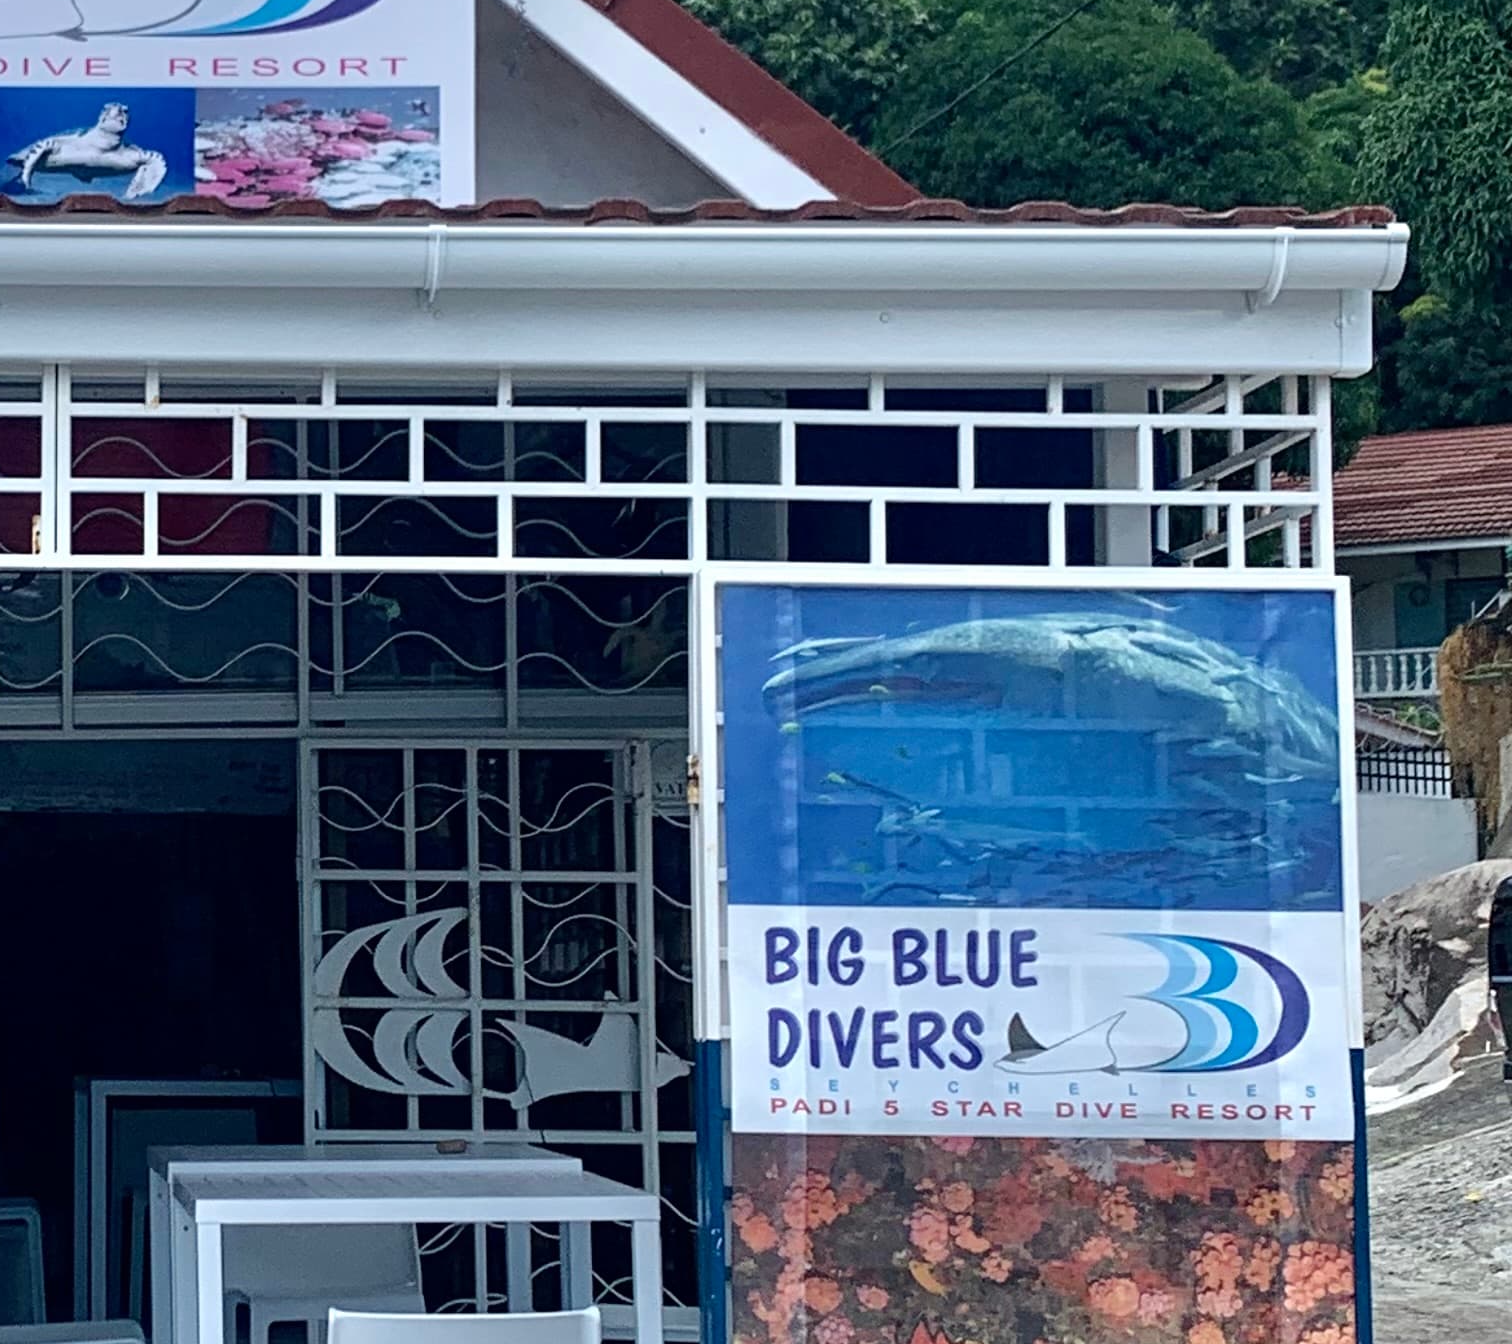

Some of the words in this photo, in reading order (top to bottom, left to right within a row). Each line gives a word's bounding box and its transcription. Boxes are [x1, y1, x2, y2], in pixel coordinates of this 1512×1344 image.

[168, 57, 409, 78] RESORT
[763, 926, 865, 987] BIG
[891, 927, 1039, 989] BLUE
[766, 1006, 986, 1071] DIVERS
[770, 1078, 1318, 1099] SEYCHELLES
[770, 1097, 852, 1115] PADI
[883, 1099, 901, 1117] 5
[930, 1100, 1024, 1118] STAR
[1055, 1101, 1138, 1120] DIVE
[1170, 1102, 1317, 1122] RESORT
